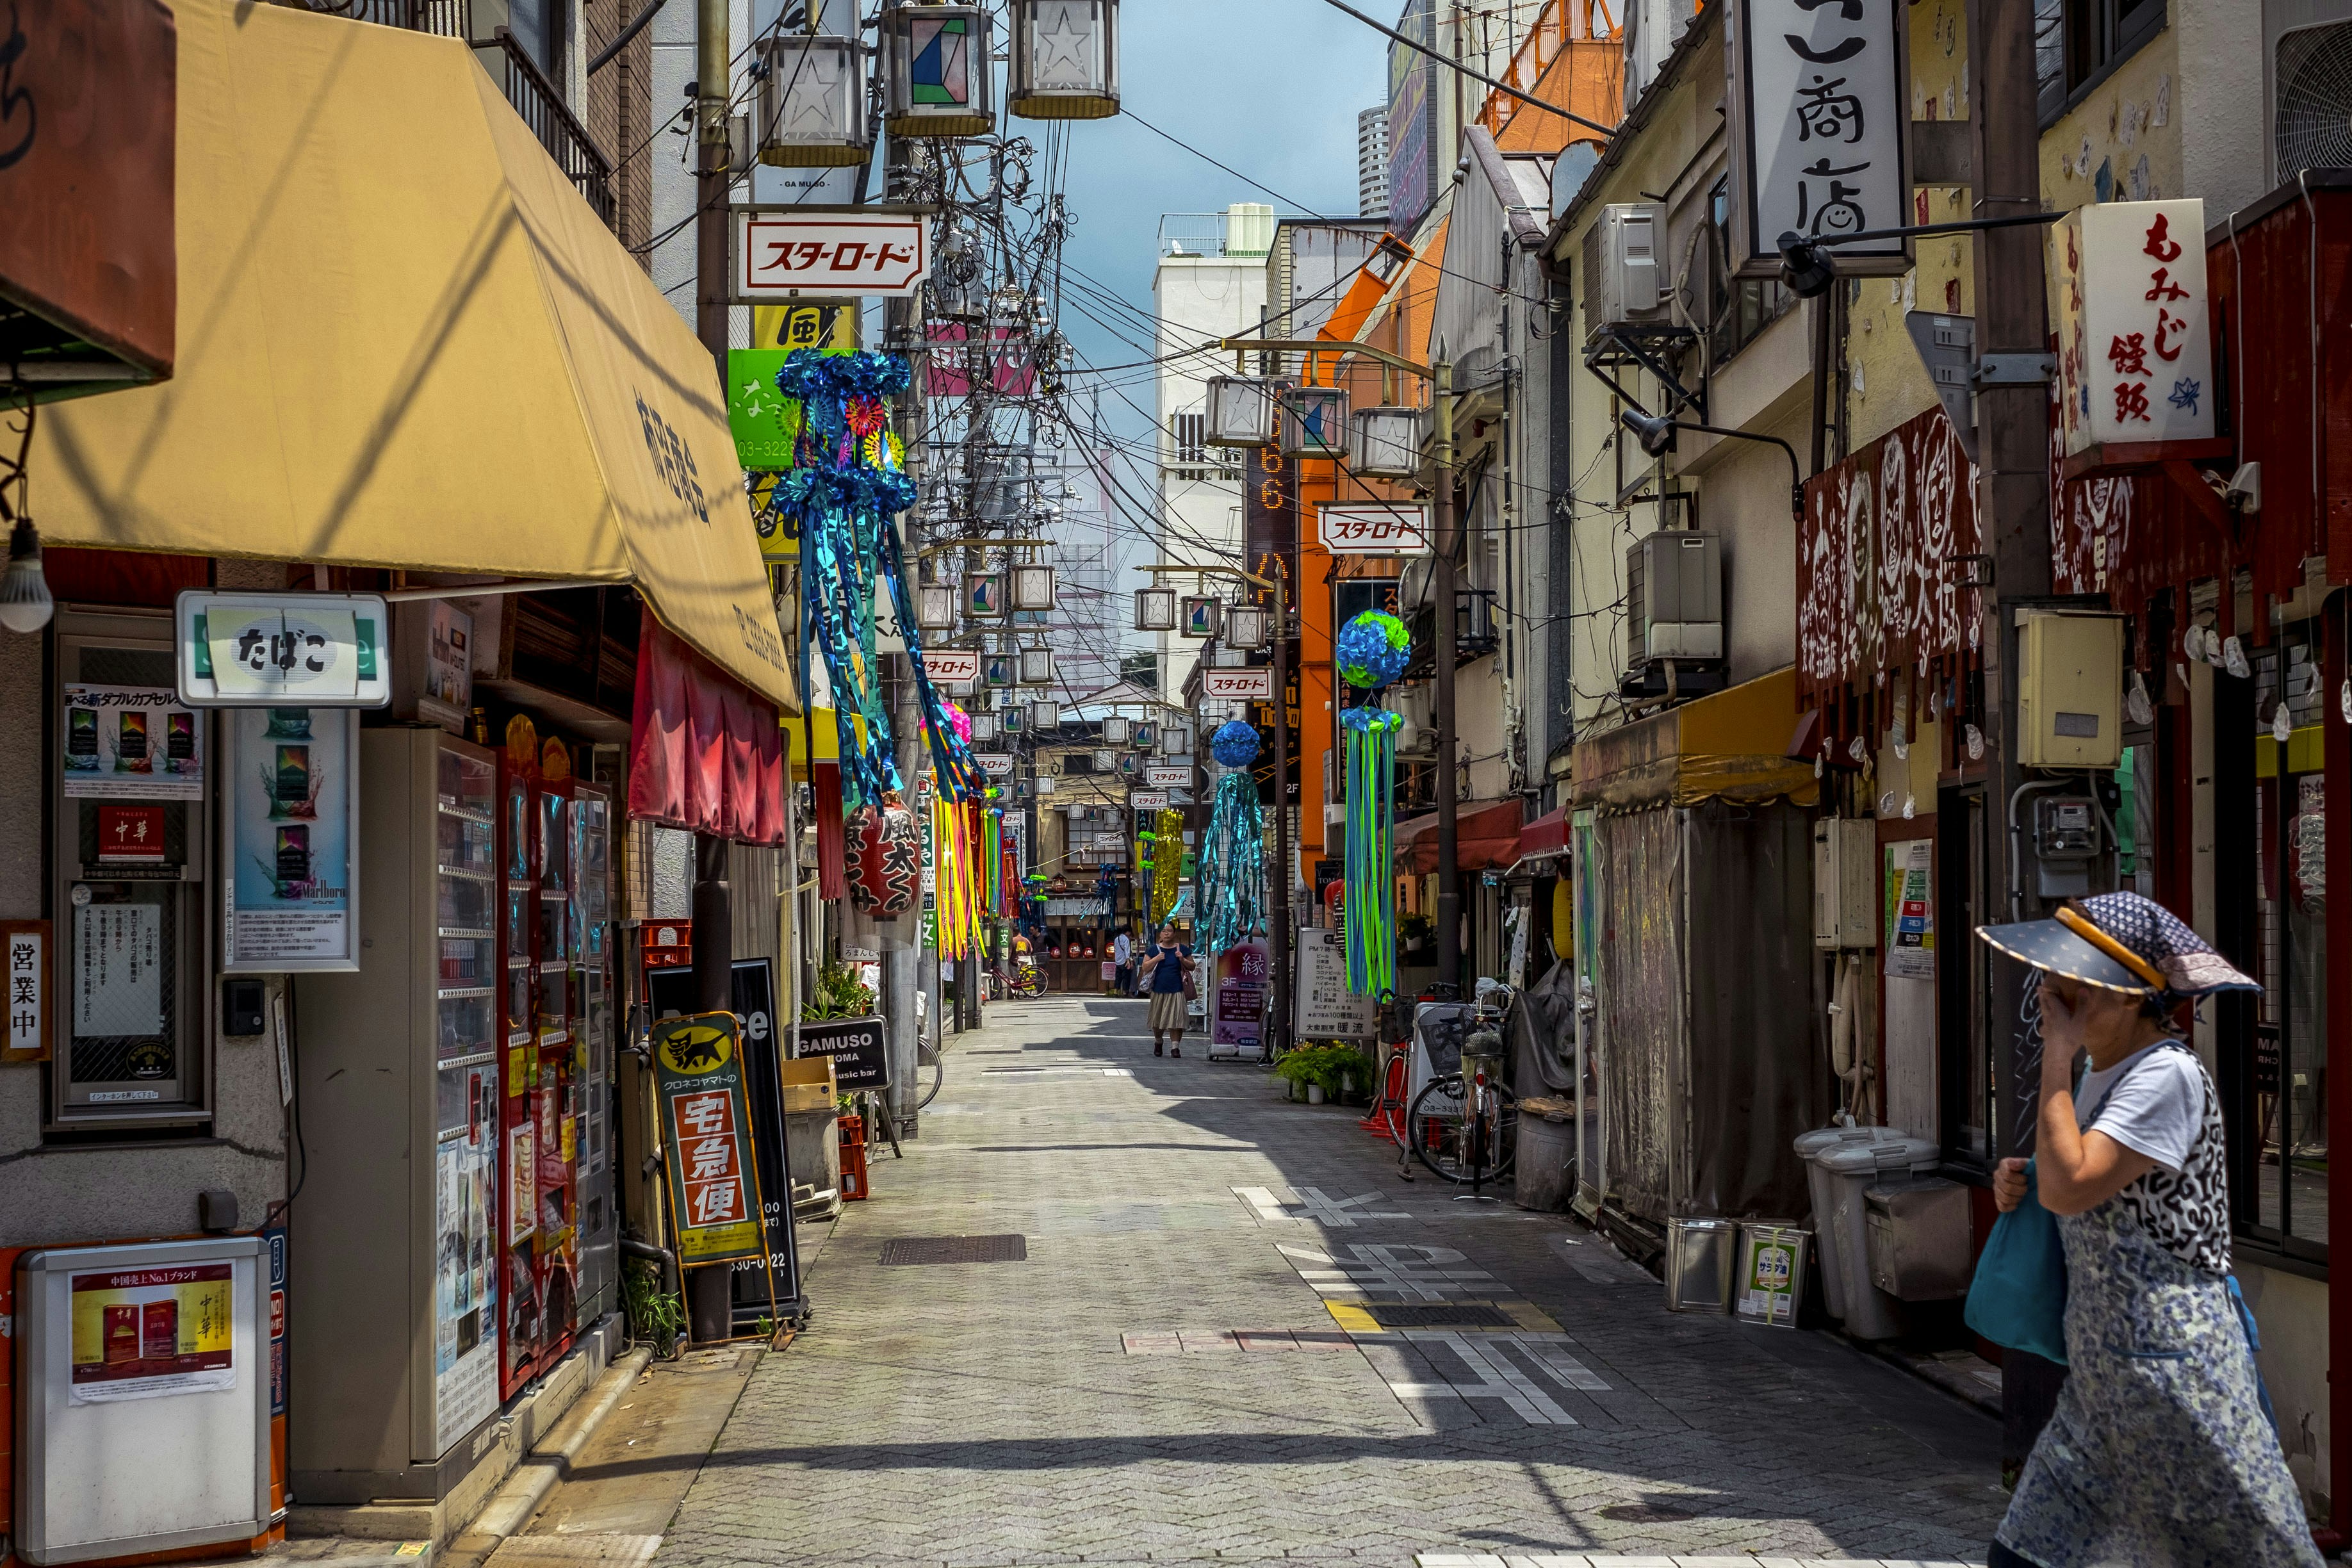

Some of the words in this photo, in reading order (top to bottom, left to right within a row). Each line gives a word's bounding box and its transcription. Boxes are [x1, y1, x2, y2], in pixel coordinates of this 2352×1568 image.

[758, 243, 914, 272] スターロード
[2143, 213, 2190, 361] もみじ
[2107, 332, 2153, 423] 饅頭
[239, 629, 325, 672] たばこ
[1211, 679, 1266, 690] スターロード
[1153, 773, 1188, 781] スターロード
[1286, 784, 1299, 794] 2F
[115, 820, 148, 843] 中華
[878, 808, 919, 913] 風太くん
[302, 879, 346, 899] Marlboro
[1241, 953, 1264, 976] 縁
[12, 943, 36, 1038] 営業中
[1221, 977, 1237, 986] 3F
[1337, 1022, 1364, 1034] 暖流
[799, 1033, 873, 1053] GAMUSO
[833, 1052, 860, 1063] OMA
[664, 1074, 737, 1091] クロネコヤマトの
[836, 1070, 858, 1080] usic
[91, 1091, 158, 1101] インターホンを押して下さい
[685, 1096, 736, 1222] 宅急便
[1760, 1262, 1788, 1275] サラダ油
[117, 1308, 132, 1320] 中華
[197, 1294, 213, 1339] 中華
